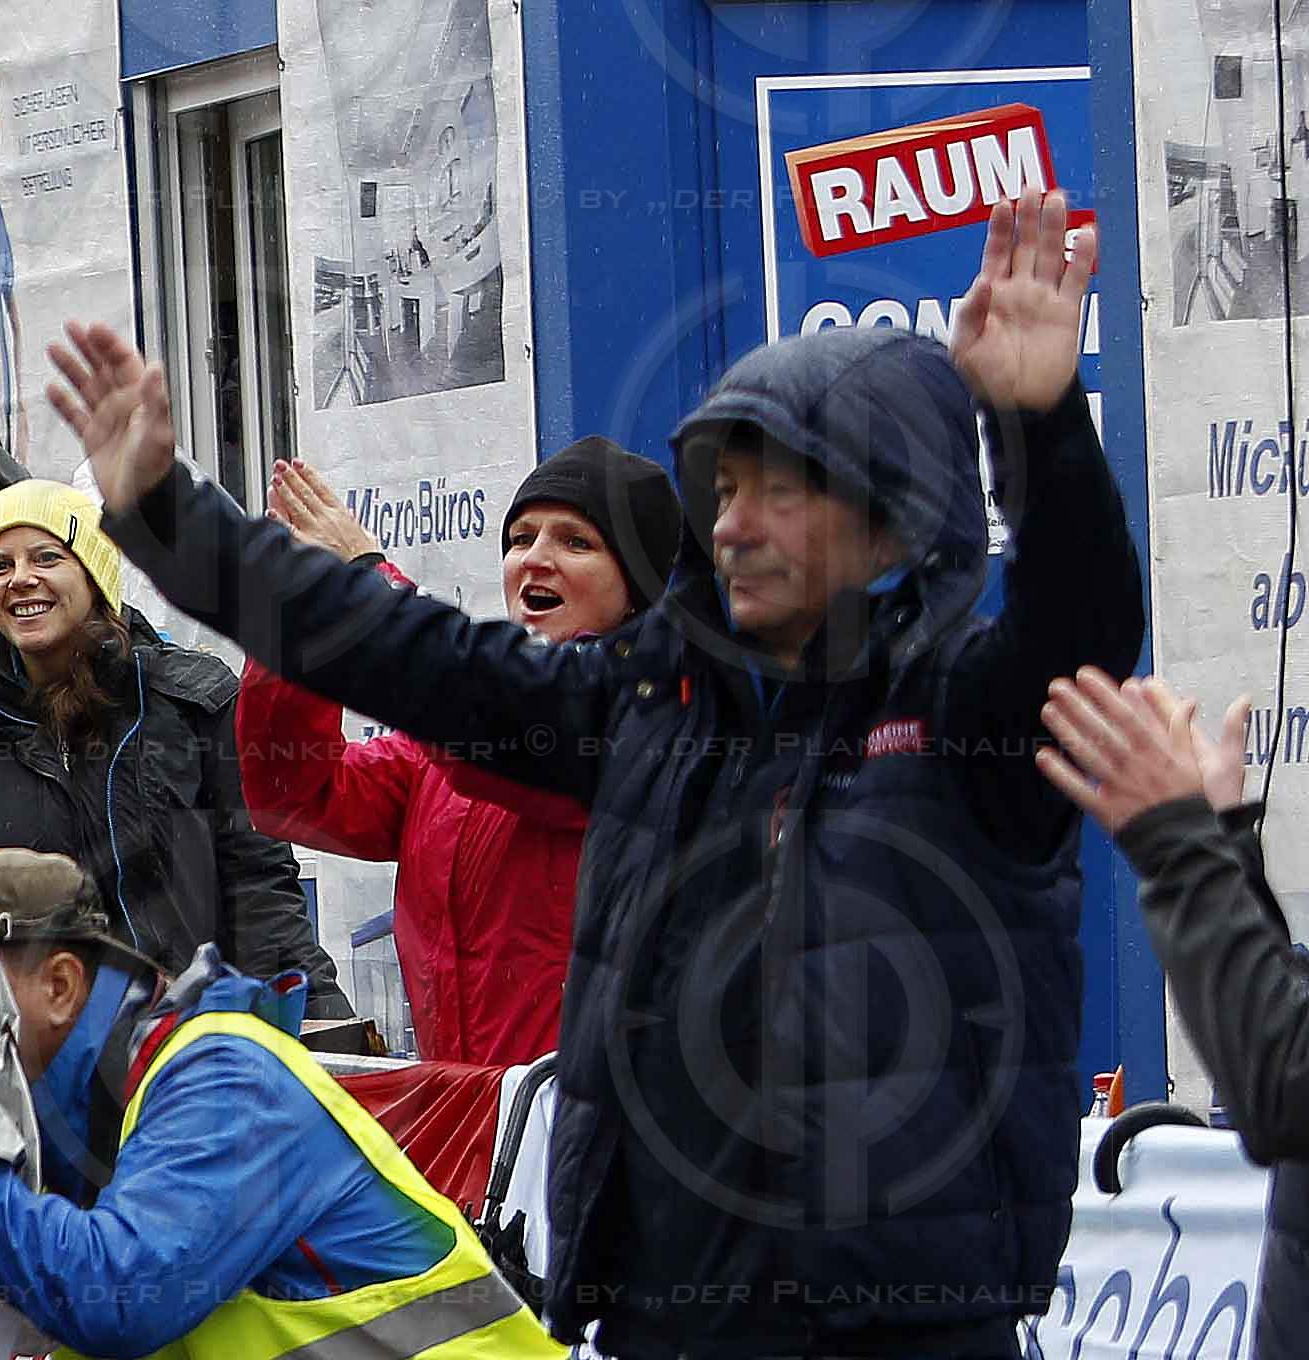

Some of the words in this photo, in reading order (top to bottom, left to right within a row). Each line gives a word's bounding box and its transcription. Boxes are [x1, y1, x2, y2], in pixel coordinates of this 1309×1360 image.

[811, 126, 1048, 242] RAUM
[345, 477, 486, 550] Micro-Büros
[1250, 552, 1306, 630] ab
